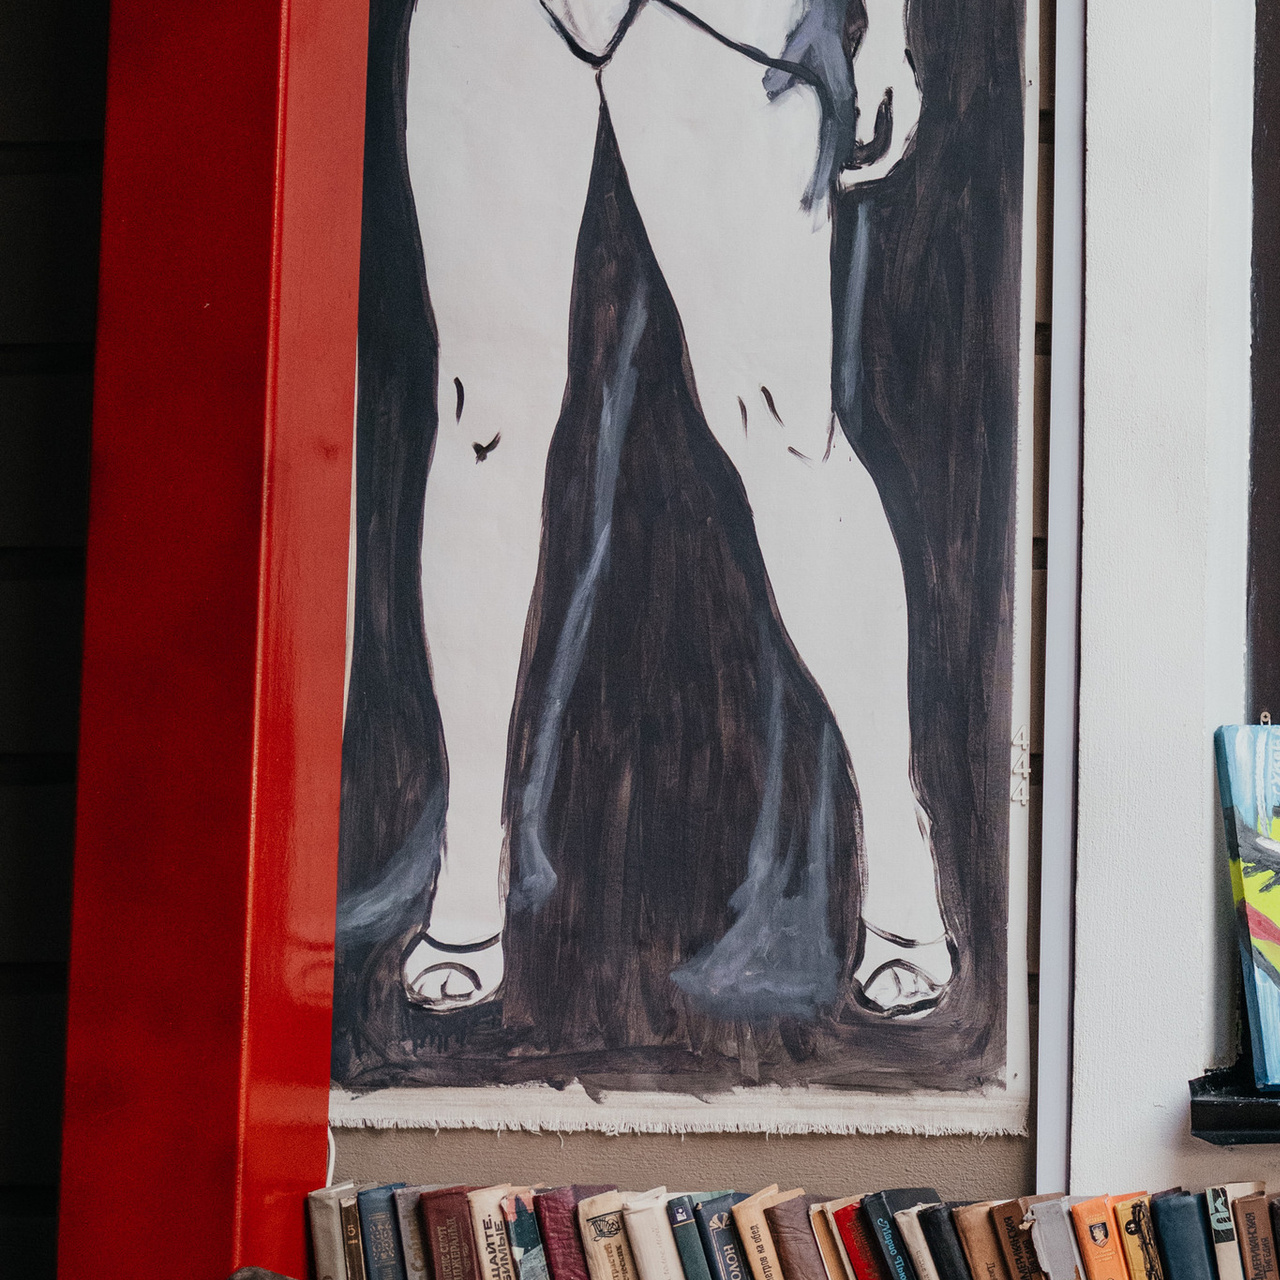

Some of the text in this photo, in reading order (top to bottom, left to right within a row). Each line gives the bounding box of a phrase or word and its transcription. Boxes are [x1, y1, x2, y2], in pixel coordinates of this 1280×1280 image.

[750, 1223, 763, 1243] обед
[877, 1217, 897, 1256] Марио
[756, 1244, 764, 1254] на
